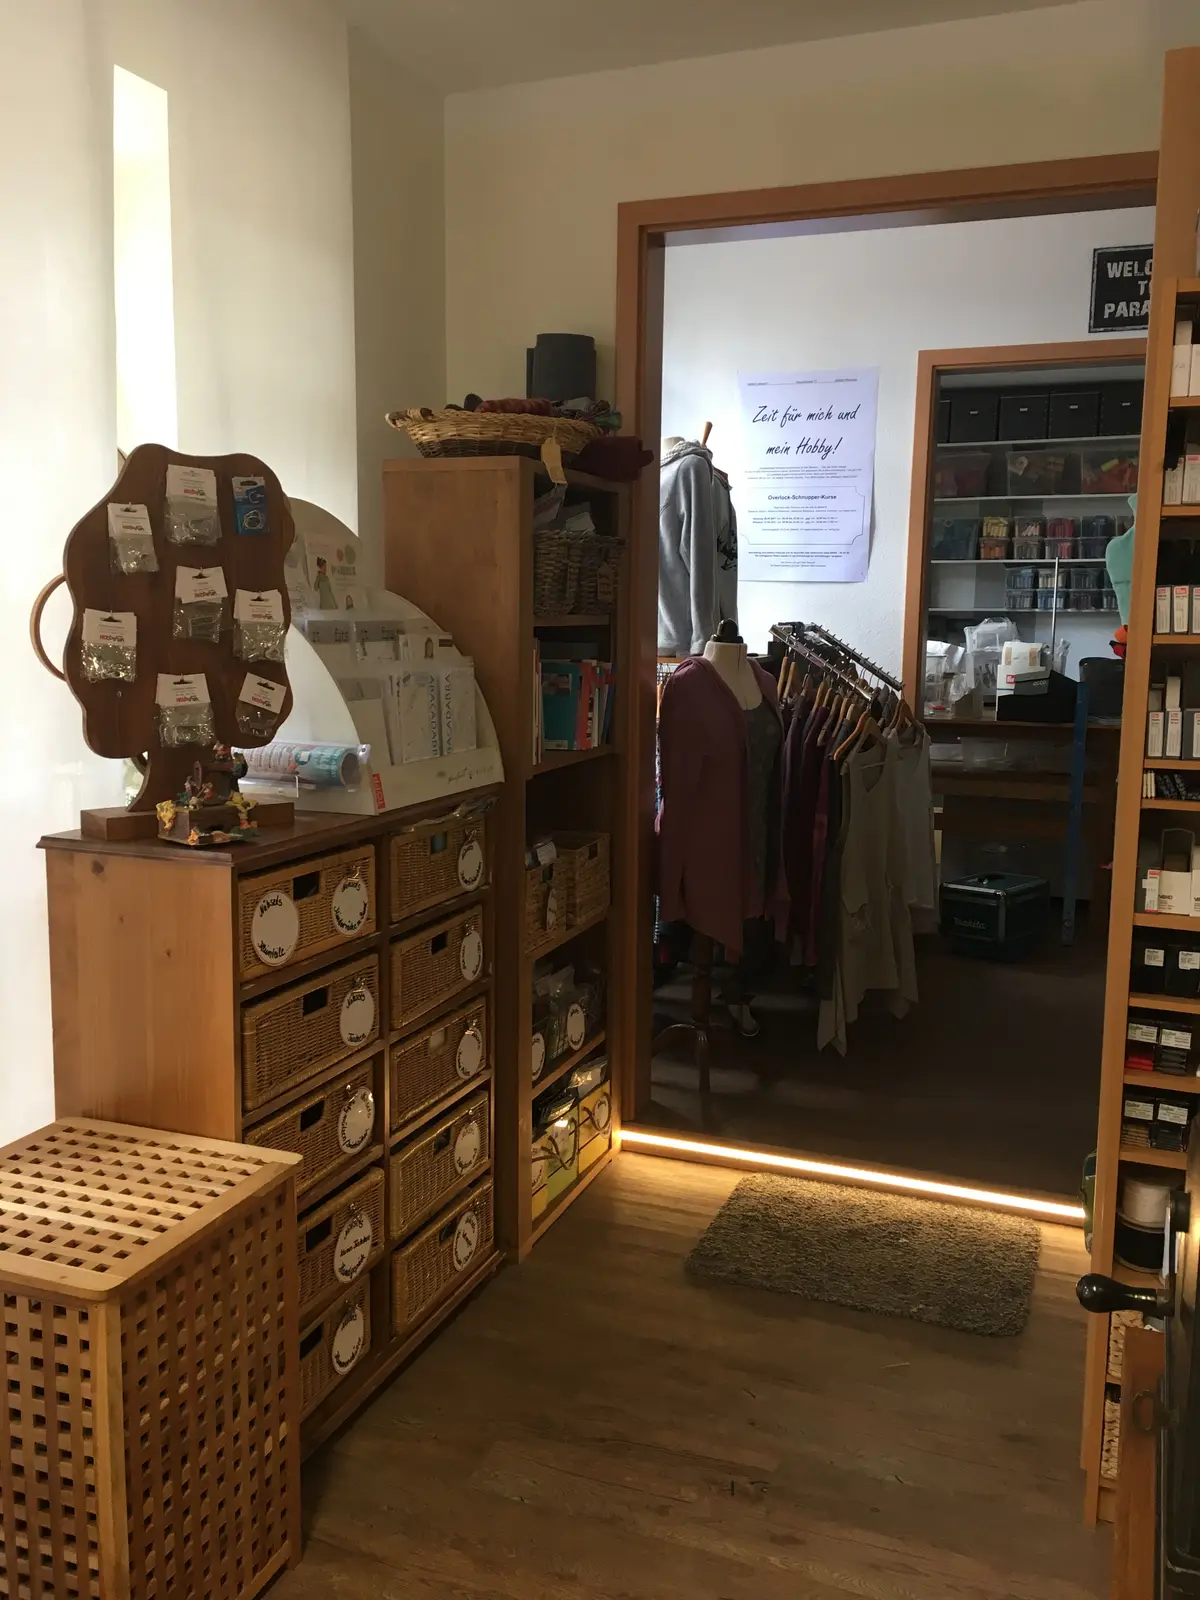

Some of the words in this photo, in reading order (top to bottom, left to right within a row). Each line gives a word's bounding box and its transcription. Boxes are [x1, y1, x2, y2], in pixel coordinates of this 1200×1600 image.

[752, 405, 779, 423] Zeit
[780, 407, 802, 428] für
[806, 407, 833, 422] mich
[838, 404, 861, 420] und
[766, 442, 790, 456] mein
[795, 437, 843, 460] Hobby!
[768, 494, 837, 502] Overlock-Schnupper-Kurse
